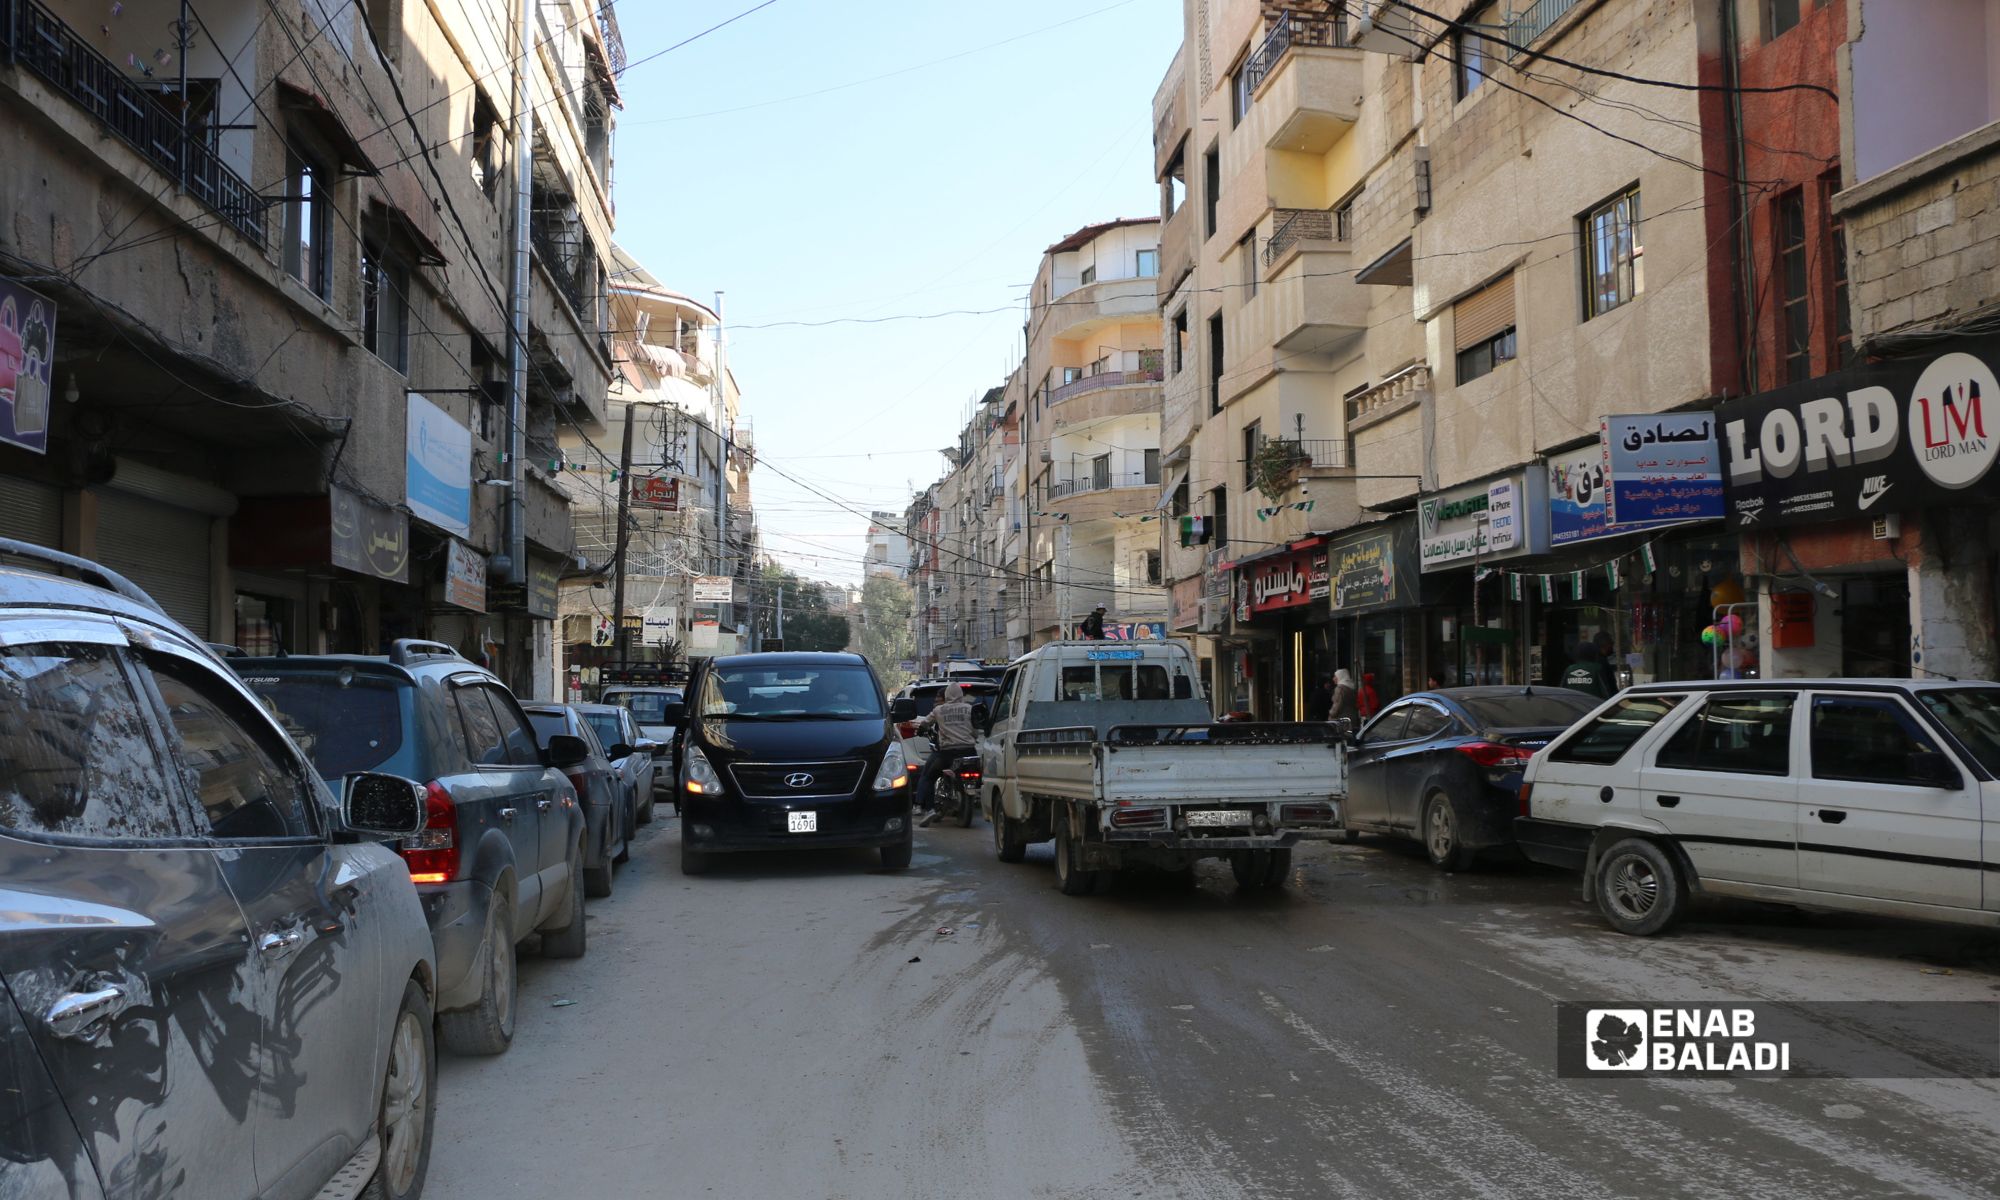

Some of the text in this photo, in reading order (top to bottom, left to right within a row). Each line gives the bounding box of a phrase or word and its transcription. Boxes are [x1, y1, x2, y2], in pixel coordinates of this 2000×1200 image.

[1726, 386, 1899, 482] LORD
[1925, 438, 1987, 462] LORD MAN
[1863, 475, 1886, 494] NIKE
[1496, 500, 1511, 512] iPhone
[1736, 497, 1765, 510] Reebok
[1492, 515, 1512, 529] TECNO
[1492, 531, 1512, 545] Infinix
[1567, 677, 1593, 685] UMBRO
[790, 820, 815, 830] 1690
